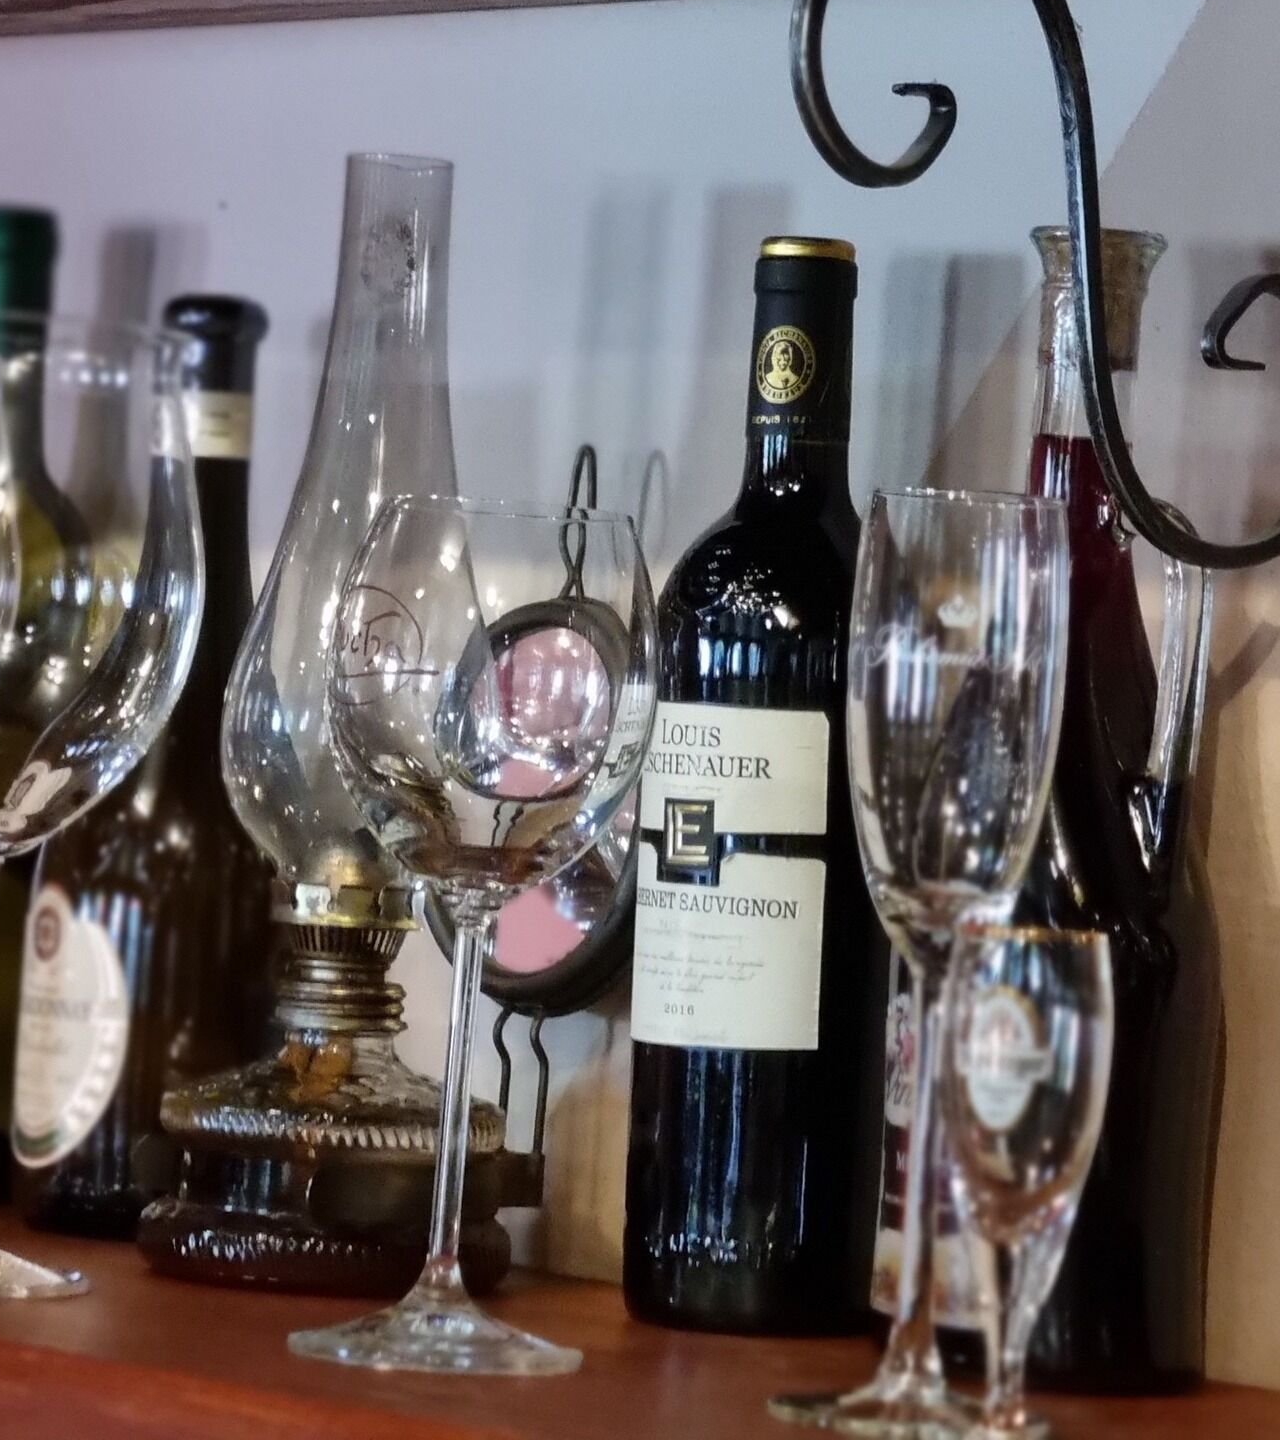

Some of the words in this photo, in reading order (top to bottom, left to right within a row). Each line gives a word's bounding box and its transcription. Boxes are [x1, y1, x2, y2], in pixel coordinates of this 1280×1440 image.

[662, 718, 721, 748] LOUIS
[644, 751, 773, 779] SCHENAUER
[679, 892, 799, 919] SAUVIGNON
[664, 1003, 695, 1016] 2016
